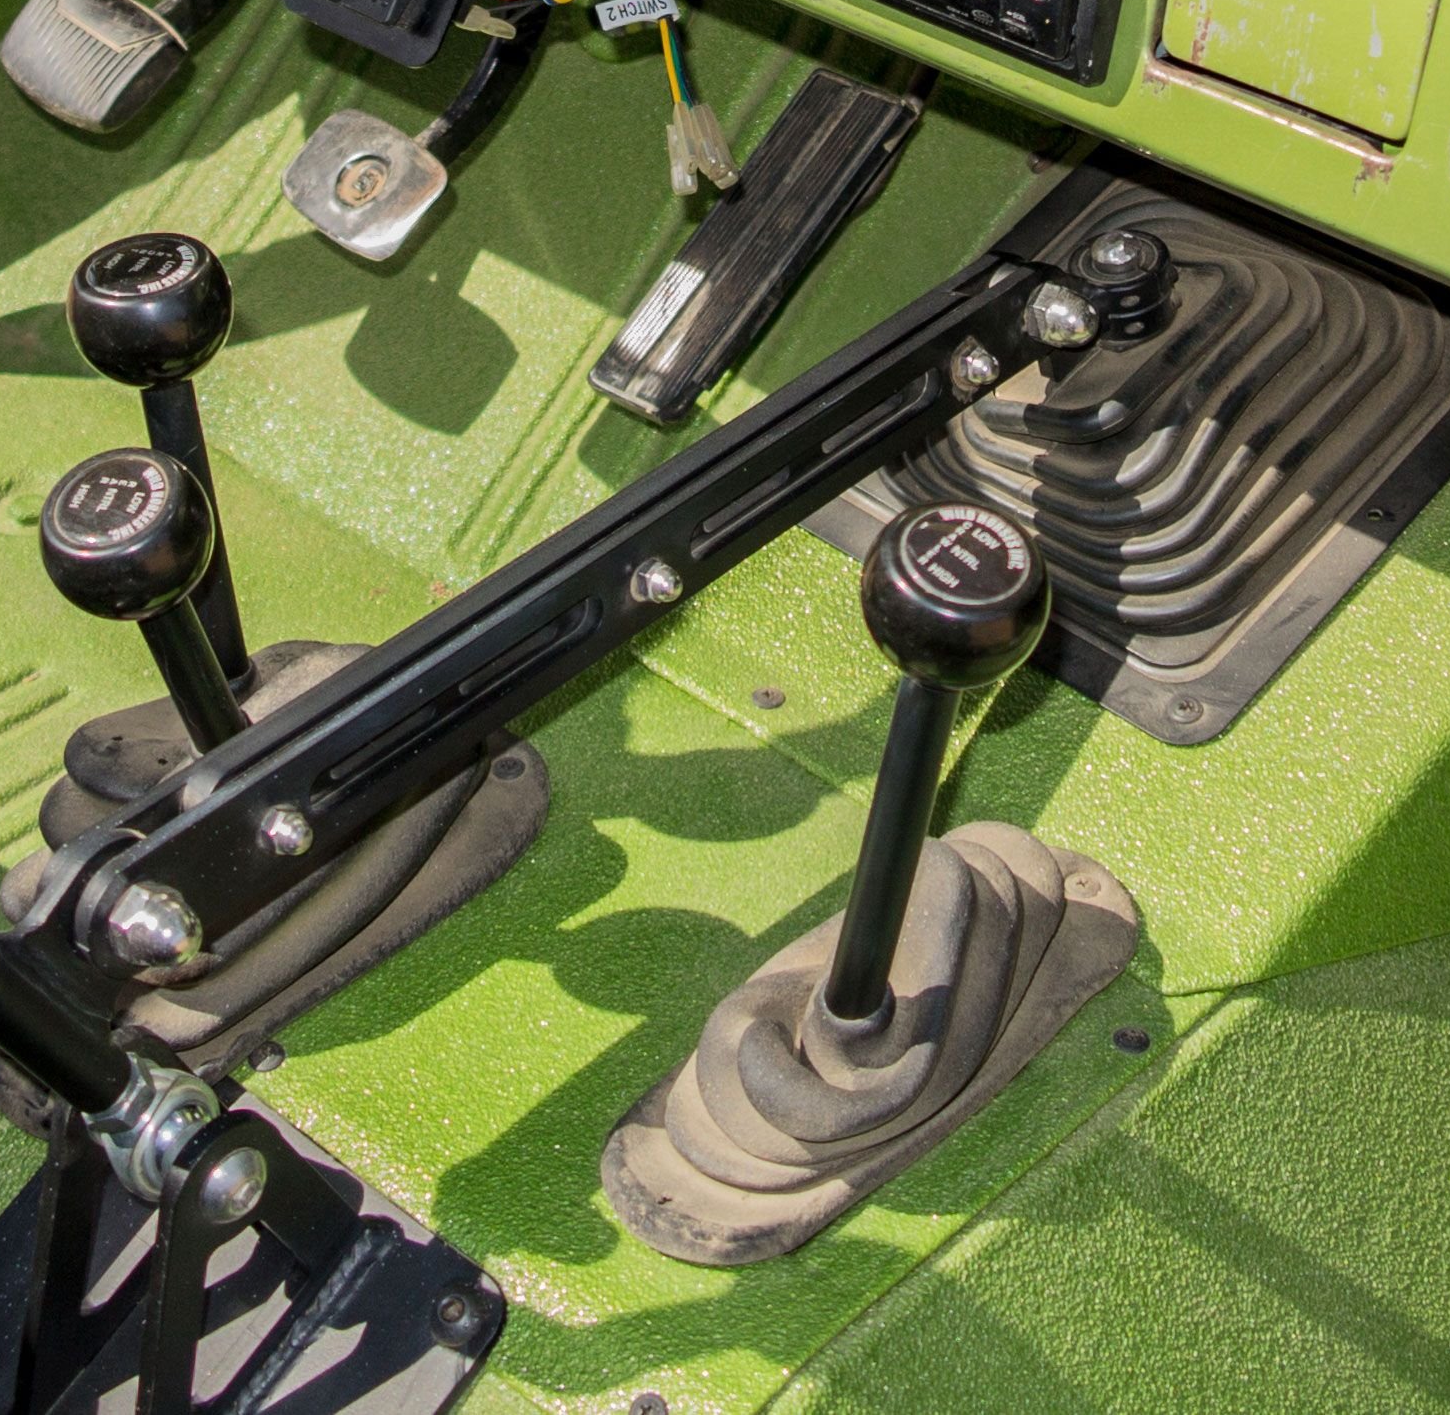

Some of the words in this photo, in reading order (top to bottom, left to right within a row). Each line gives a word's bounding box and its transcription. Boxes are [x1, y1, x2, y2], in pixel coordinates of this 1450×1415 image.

[606, 6, 618, 21] 2
[126, 492, 146, 515] LOW
[971, 528, 1001, 550] LOW
[950, 544, 981, 571] NTRL
[927, 563, 959, 588] HIGH
